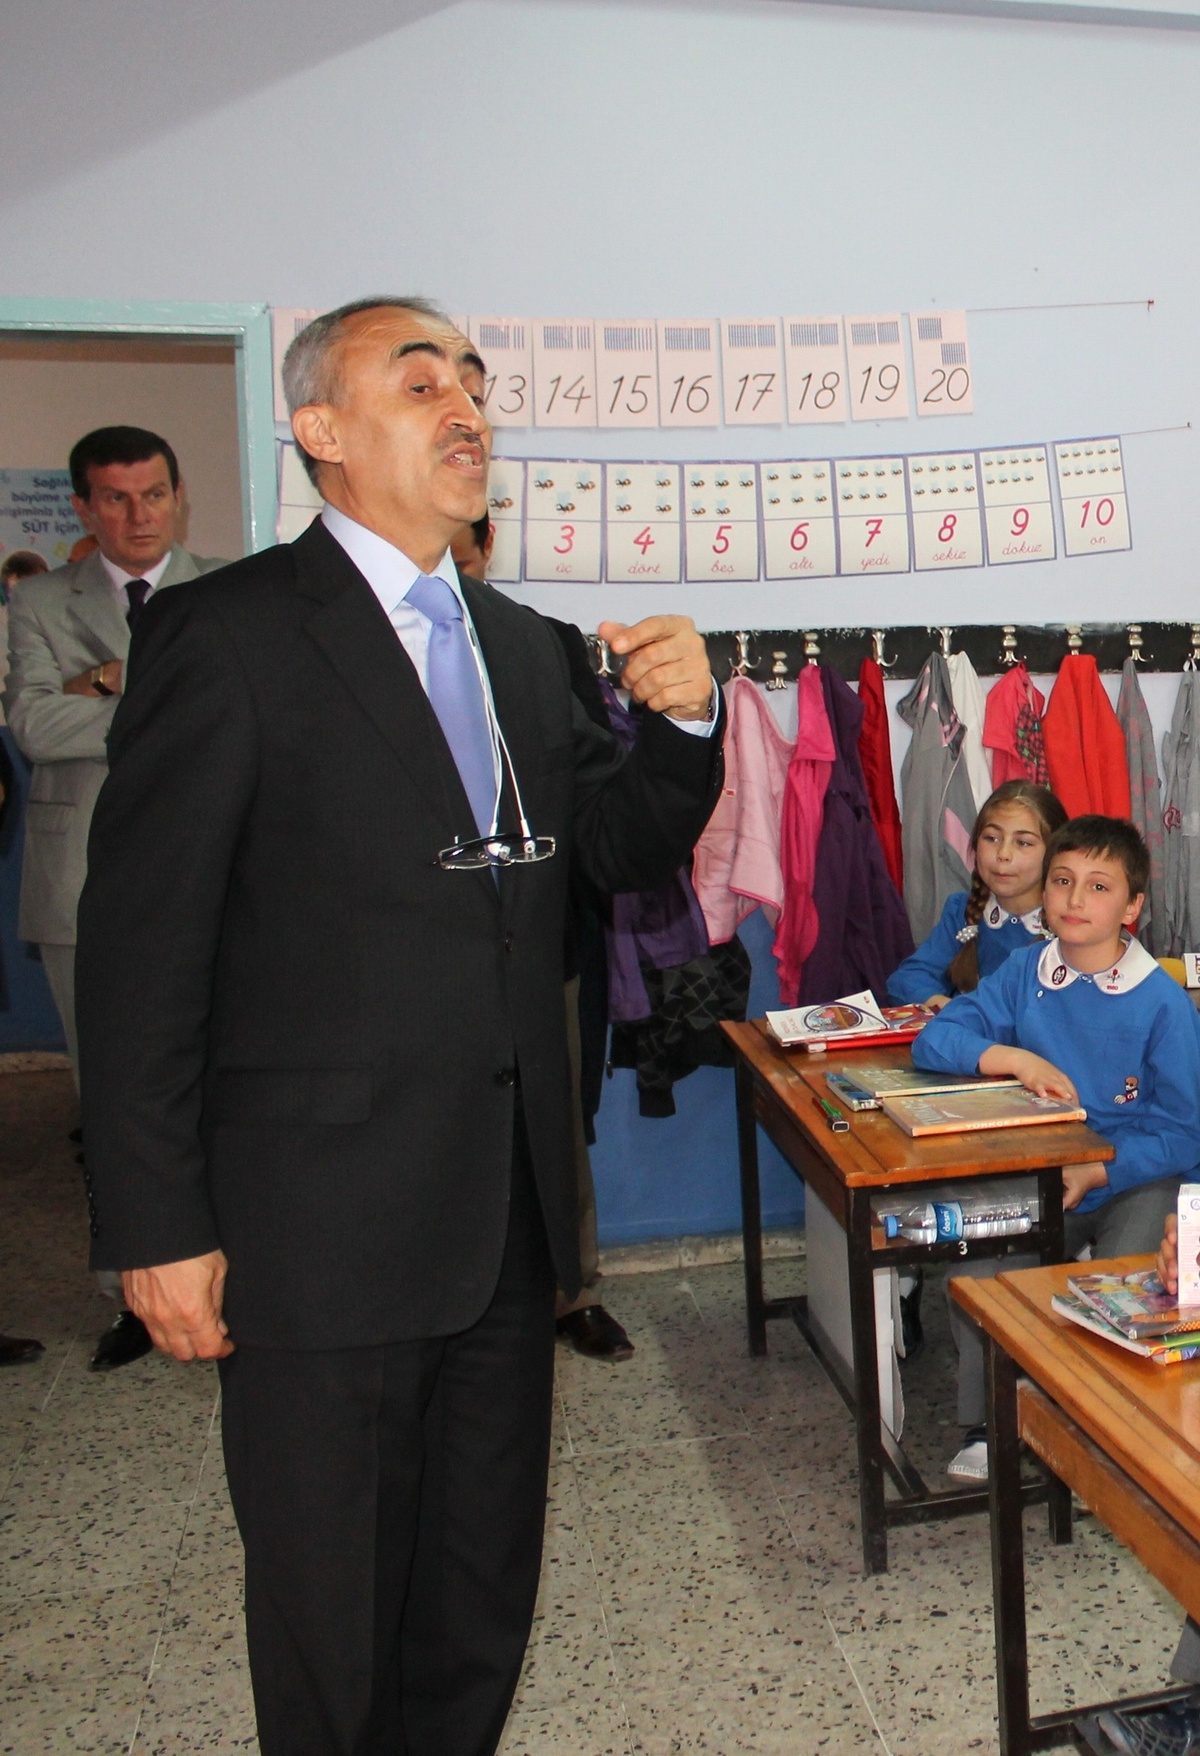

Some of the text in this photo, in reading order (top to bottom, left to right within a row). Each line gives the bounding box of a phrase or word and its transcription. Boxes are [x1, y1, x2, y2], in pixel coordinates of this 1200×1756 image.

[484, 375, 526, 413] 13
[546, 375, 591, 414] 14
[609, 375, 652, 414] 15
[670, 374, 712, 414] 16
[735, 373, 776, 412] 17
[798, 371, 840, 410] 18
[860, 364, 901, 404] 19
[923, 367, 970, 403] 20
[21, 519, 80, 536] SÜT için
[1010, 507, 1030, 536] 9
[1081, 498, 1115, 528] 10
[553, 524, 575, 554] 3
[633, 526, 655, 555] 4
[712, 525, 732, 554] 5
[790, 522, 810, 551] 6
[865, 519, 883, 547] 7
[938, 514, 957, 542] 8
[1089, 536, 1107, 546] on
[861, 553, 890, 571] yedi
[932, 547, 967, 562] sekiz
[1002, 542, 1042, 556] dokuz
[555, 562, 573, 574] üç
[711, 560, 735, 574] beş
[958, 1240, 968, 1255] 3
